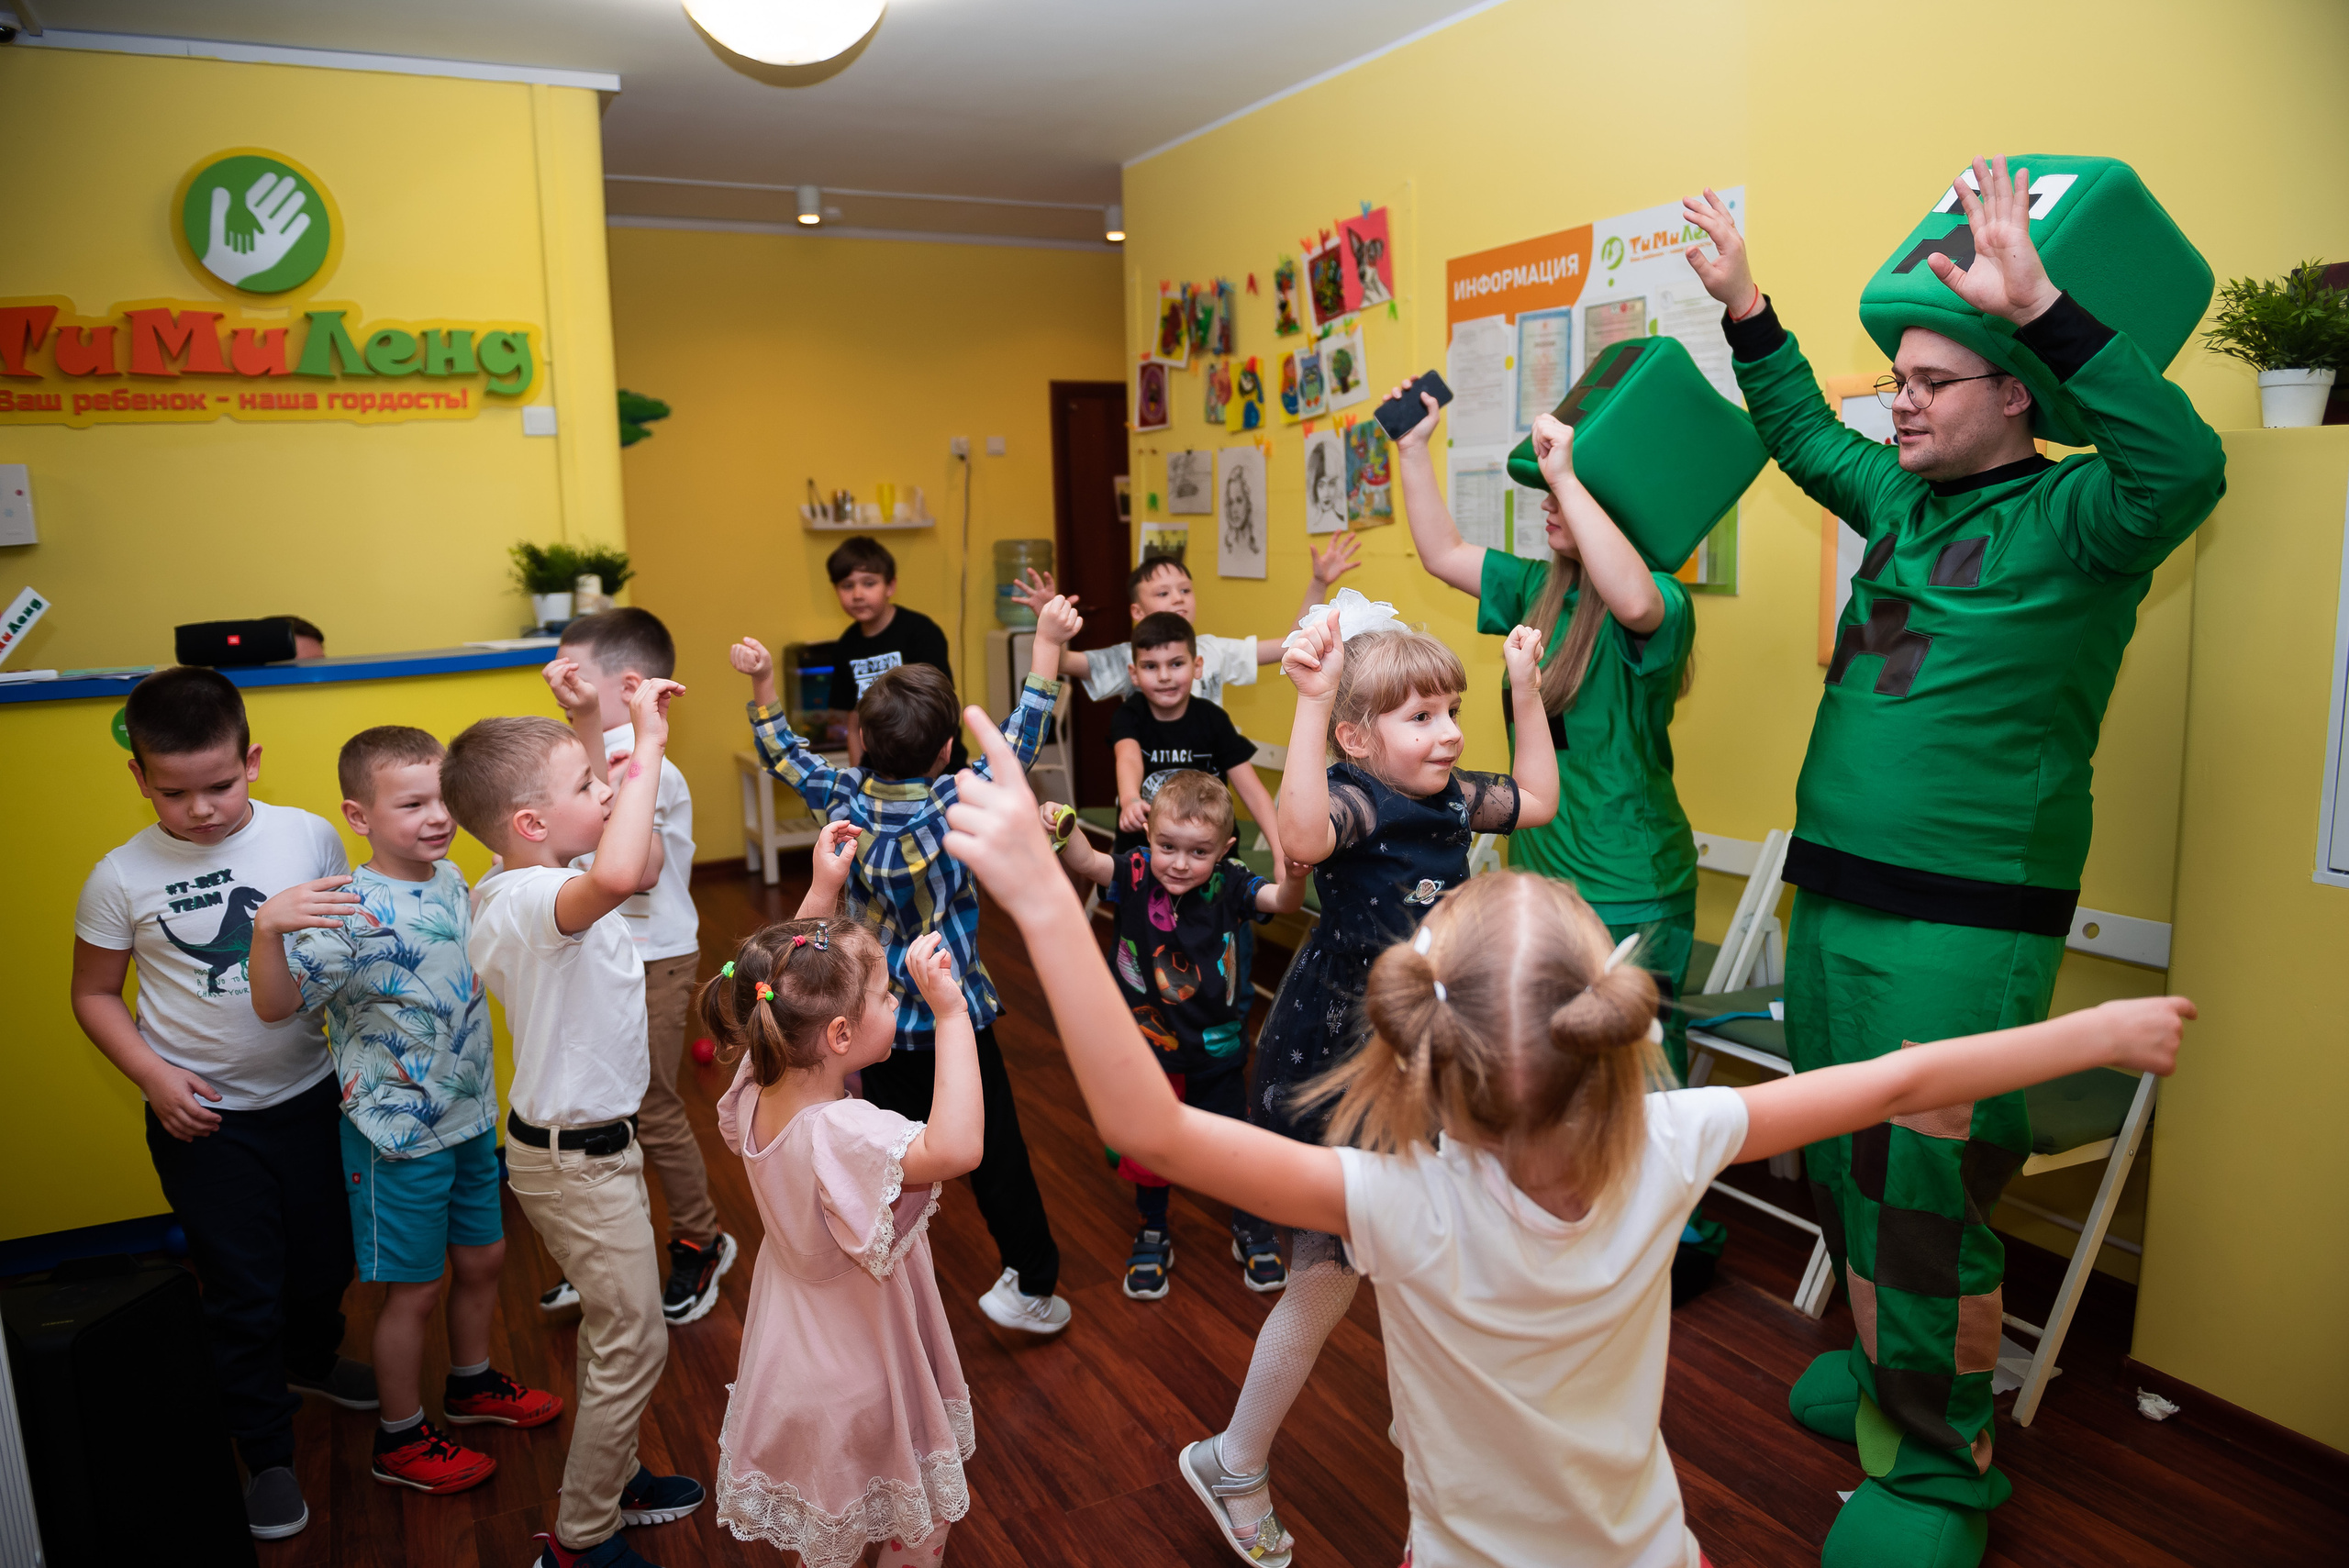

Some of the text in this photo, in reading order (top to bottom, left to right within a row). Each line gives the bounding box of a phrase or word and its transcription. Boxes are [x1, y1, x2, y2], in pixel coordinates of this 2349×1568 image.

[1629, 224, 1710, 254] ТиМиЛе
[1453, 253, 1579, 302] ИНФОРМАЦИЯ
[72, 388, 207, 416] ребенок
[239, 393, 318, 411] наша
[327, 388, 468, 413] гордость!
[1150, 749, 1193, 763] ATTACK
[165, 869, 235, 895] #T-REX
[169, 891, 224, 914] TEAM
[196, 978, 203, 987] A
[228, 987, 250, 996] YOUR
